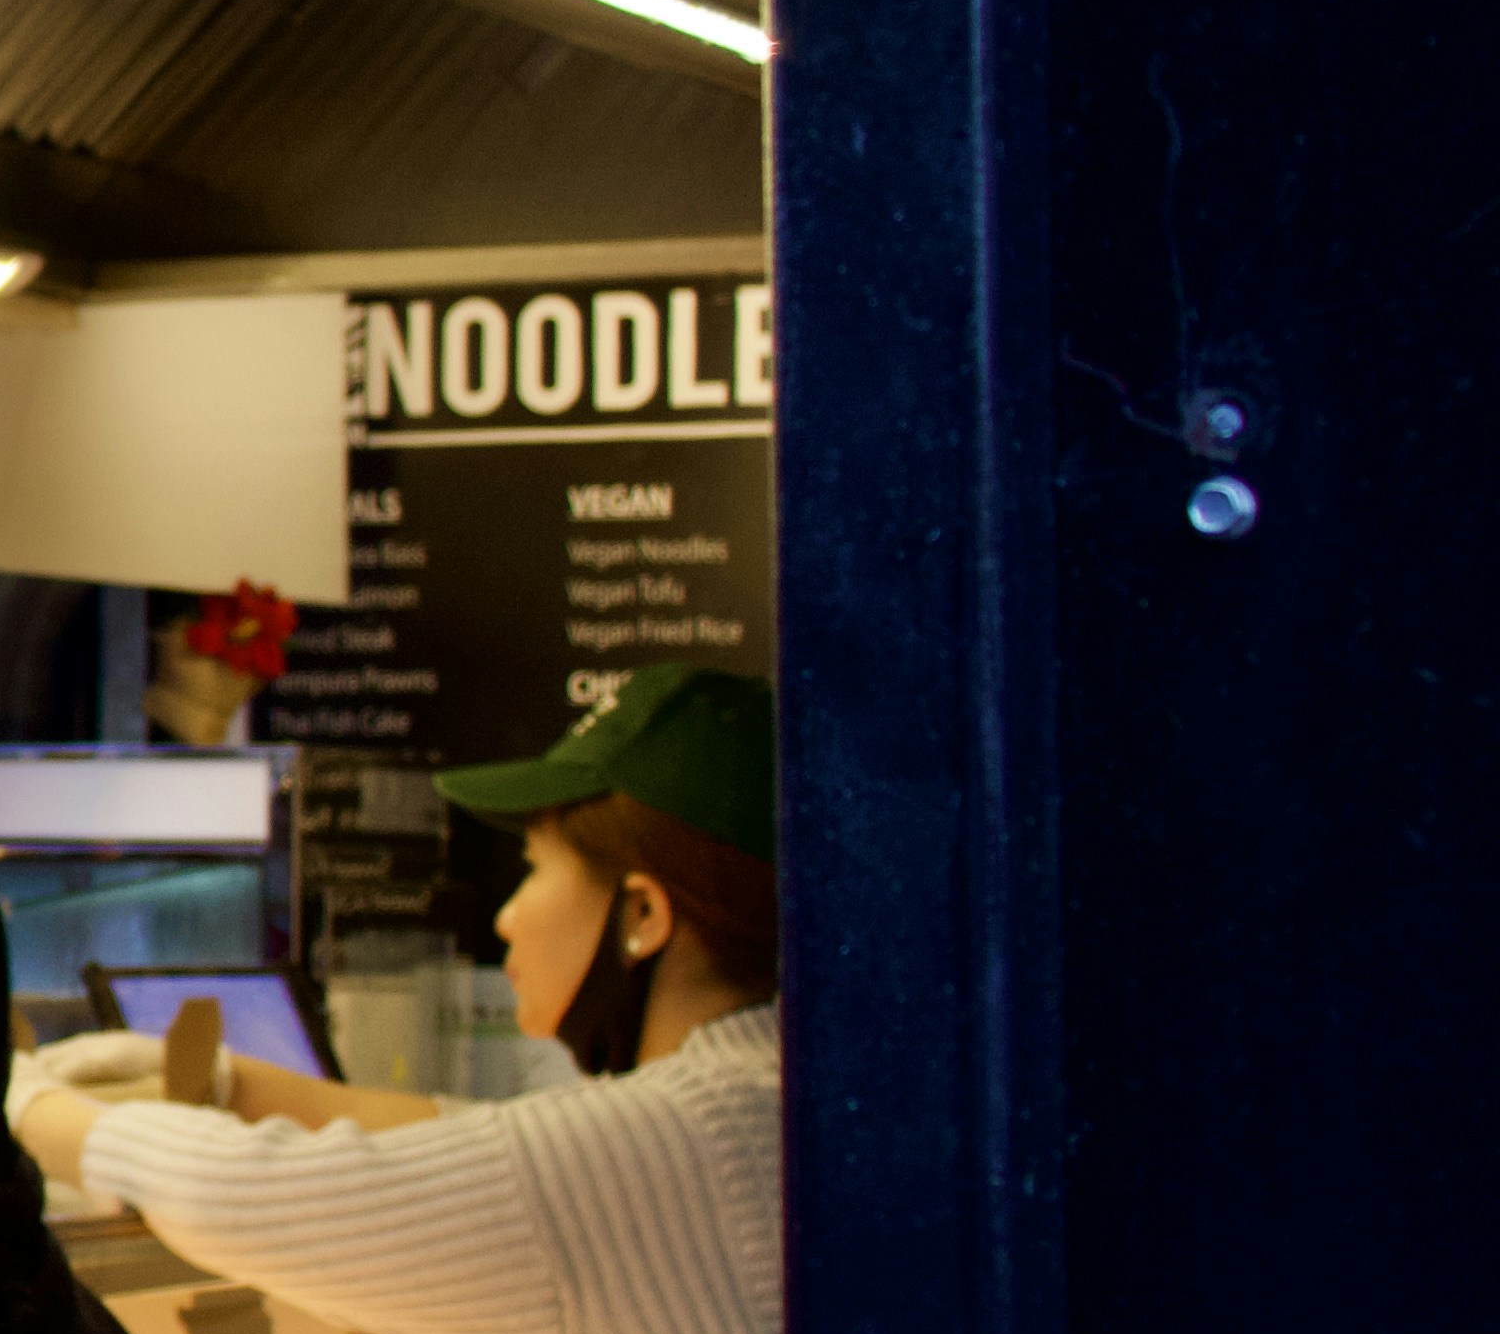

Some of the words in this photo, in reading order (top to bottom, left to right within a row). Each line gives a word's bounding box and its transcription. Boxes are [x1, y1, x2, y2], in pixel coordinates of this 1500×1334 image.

[566, 483, 674, 521] VEGAN
[565, 540, 636, 571] Vegan
[637, 535, 729, 564] Noodles
[565, 578, 636, 611] Vegan
[565, 620, 636, 653] Vegan
